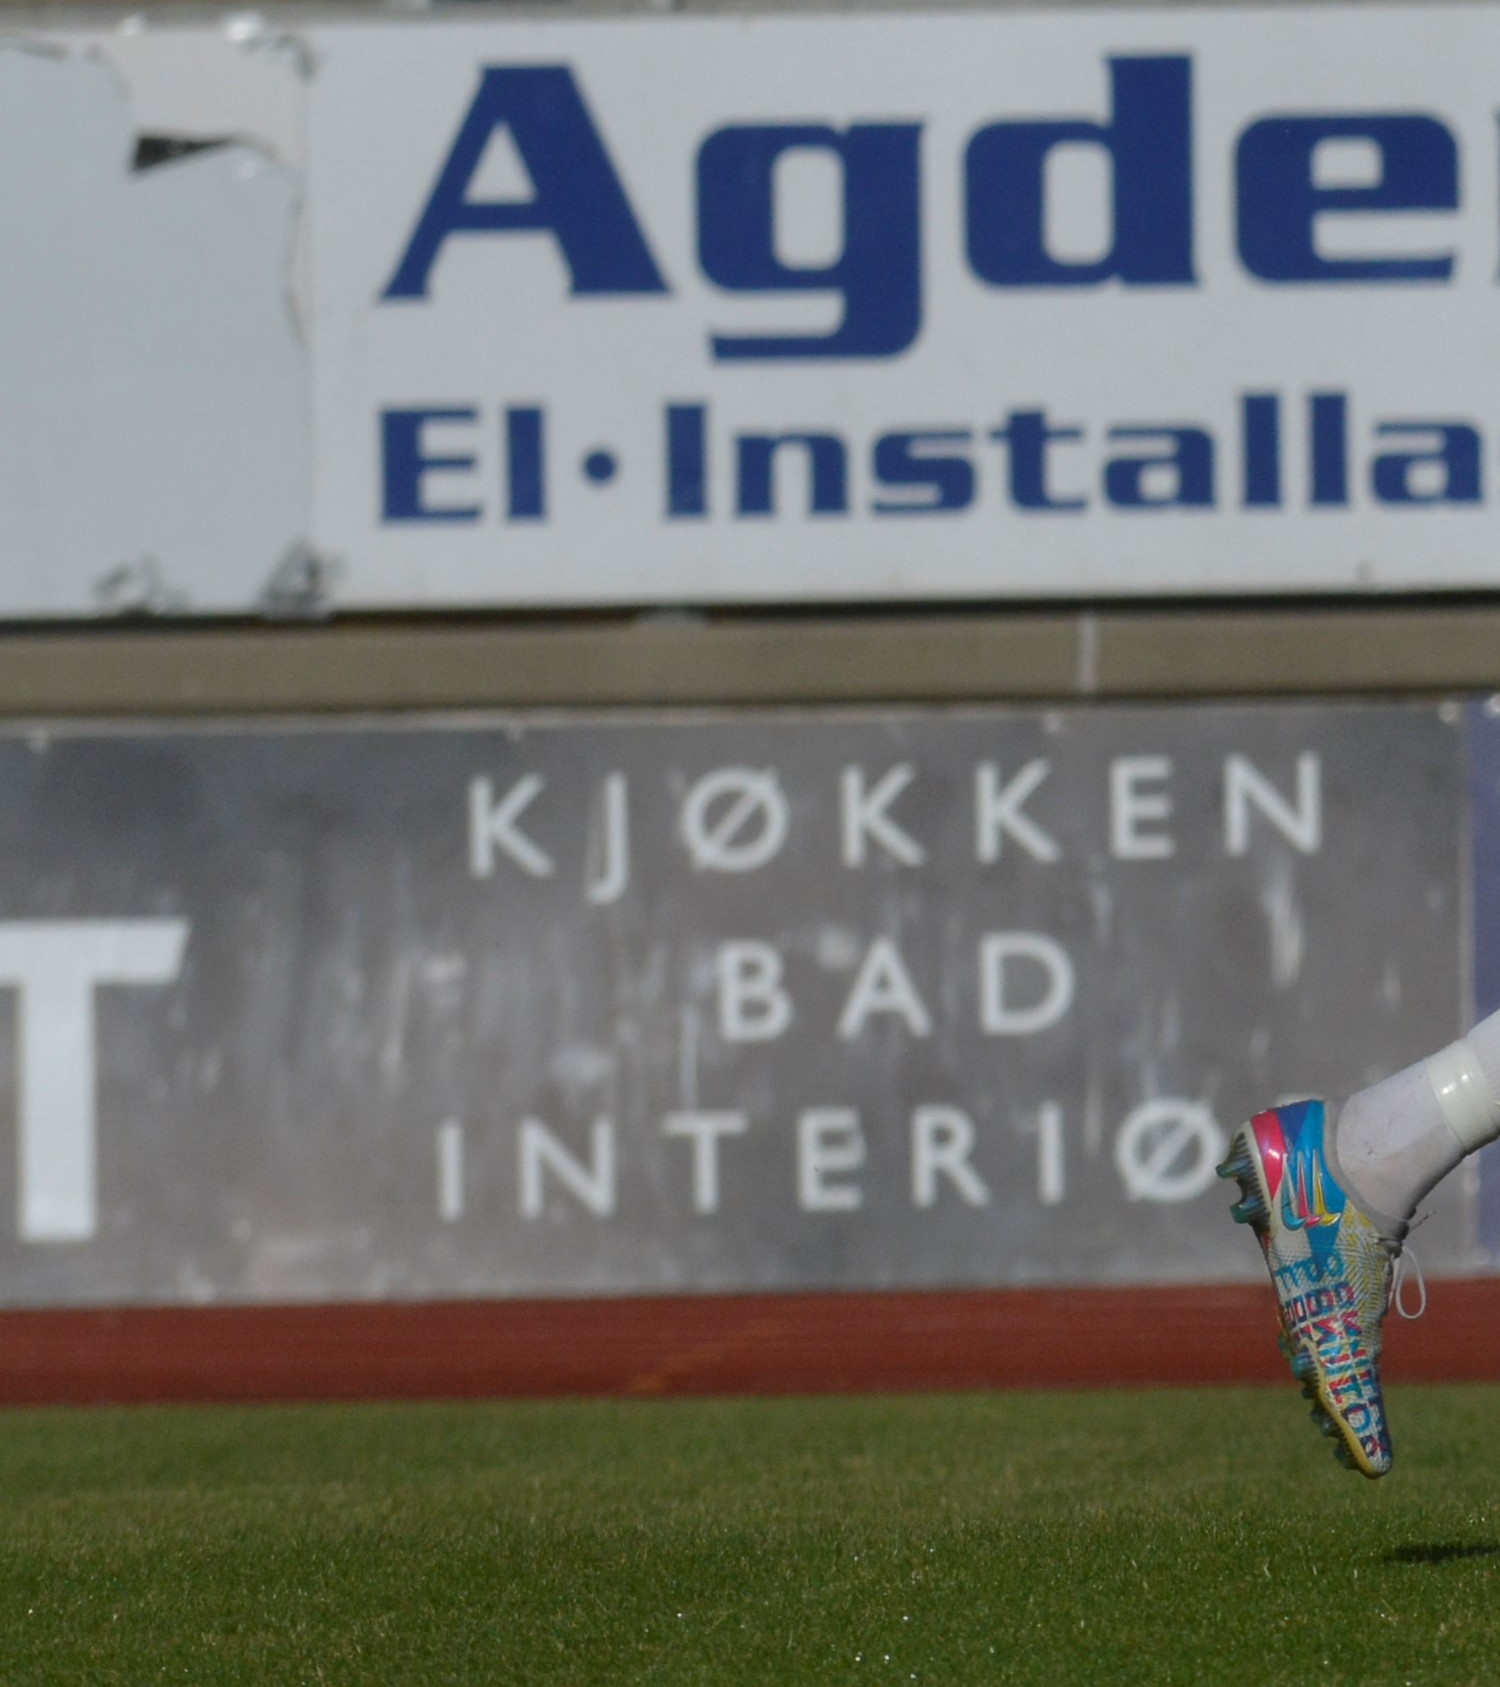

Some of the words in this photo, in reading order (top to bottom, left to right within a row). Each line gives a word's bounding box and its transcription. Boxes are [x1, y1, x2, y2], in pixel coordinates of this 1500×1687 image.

[467, 752, 1324, 907] KJØKKEN
[716, 932, 1075, 1044] BAD
[436, 1097, 1226, 1222] INTERIØ
